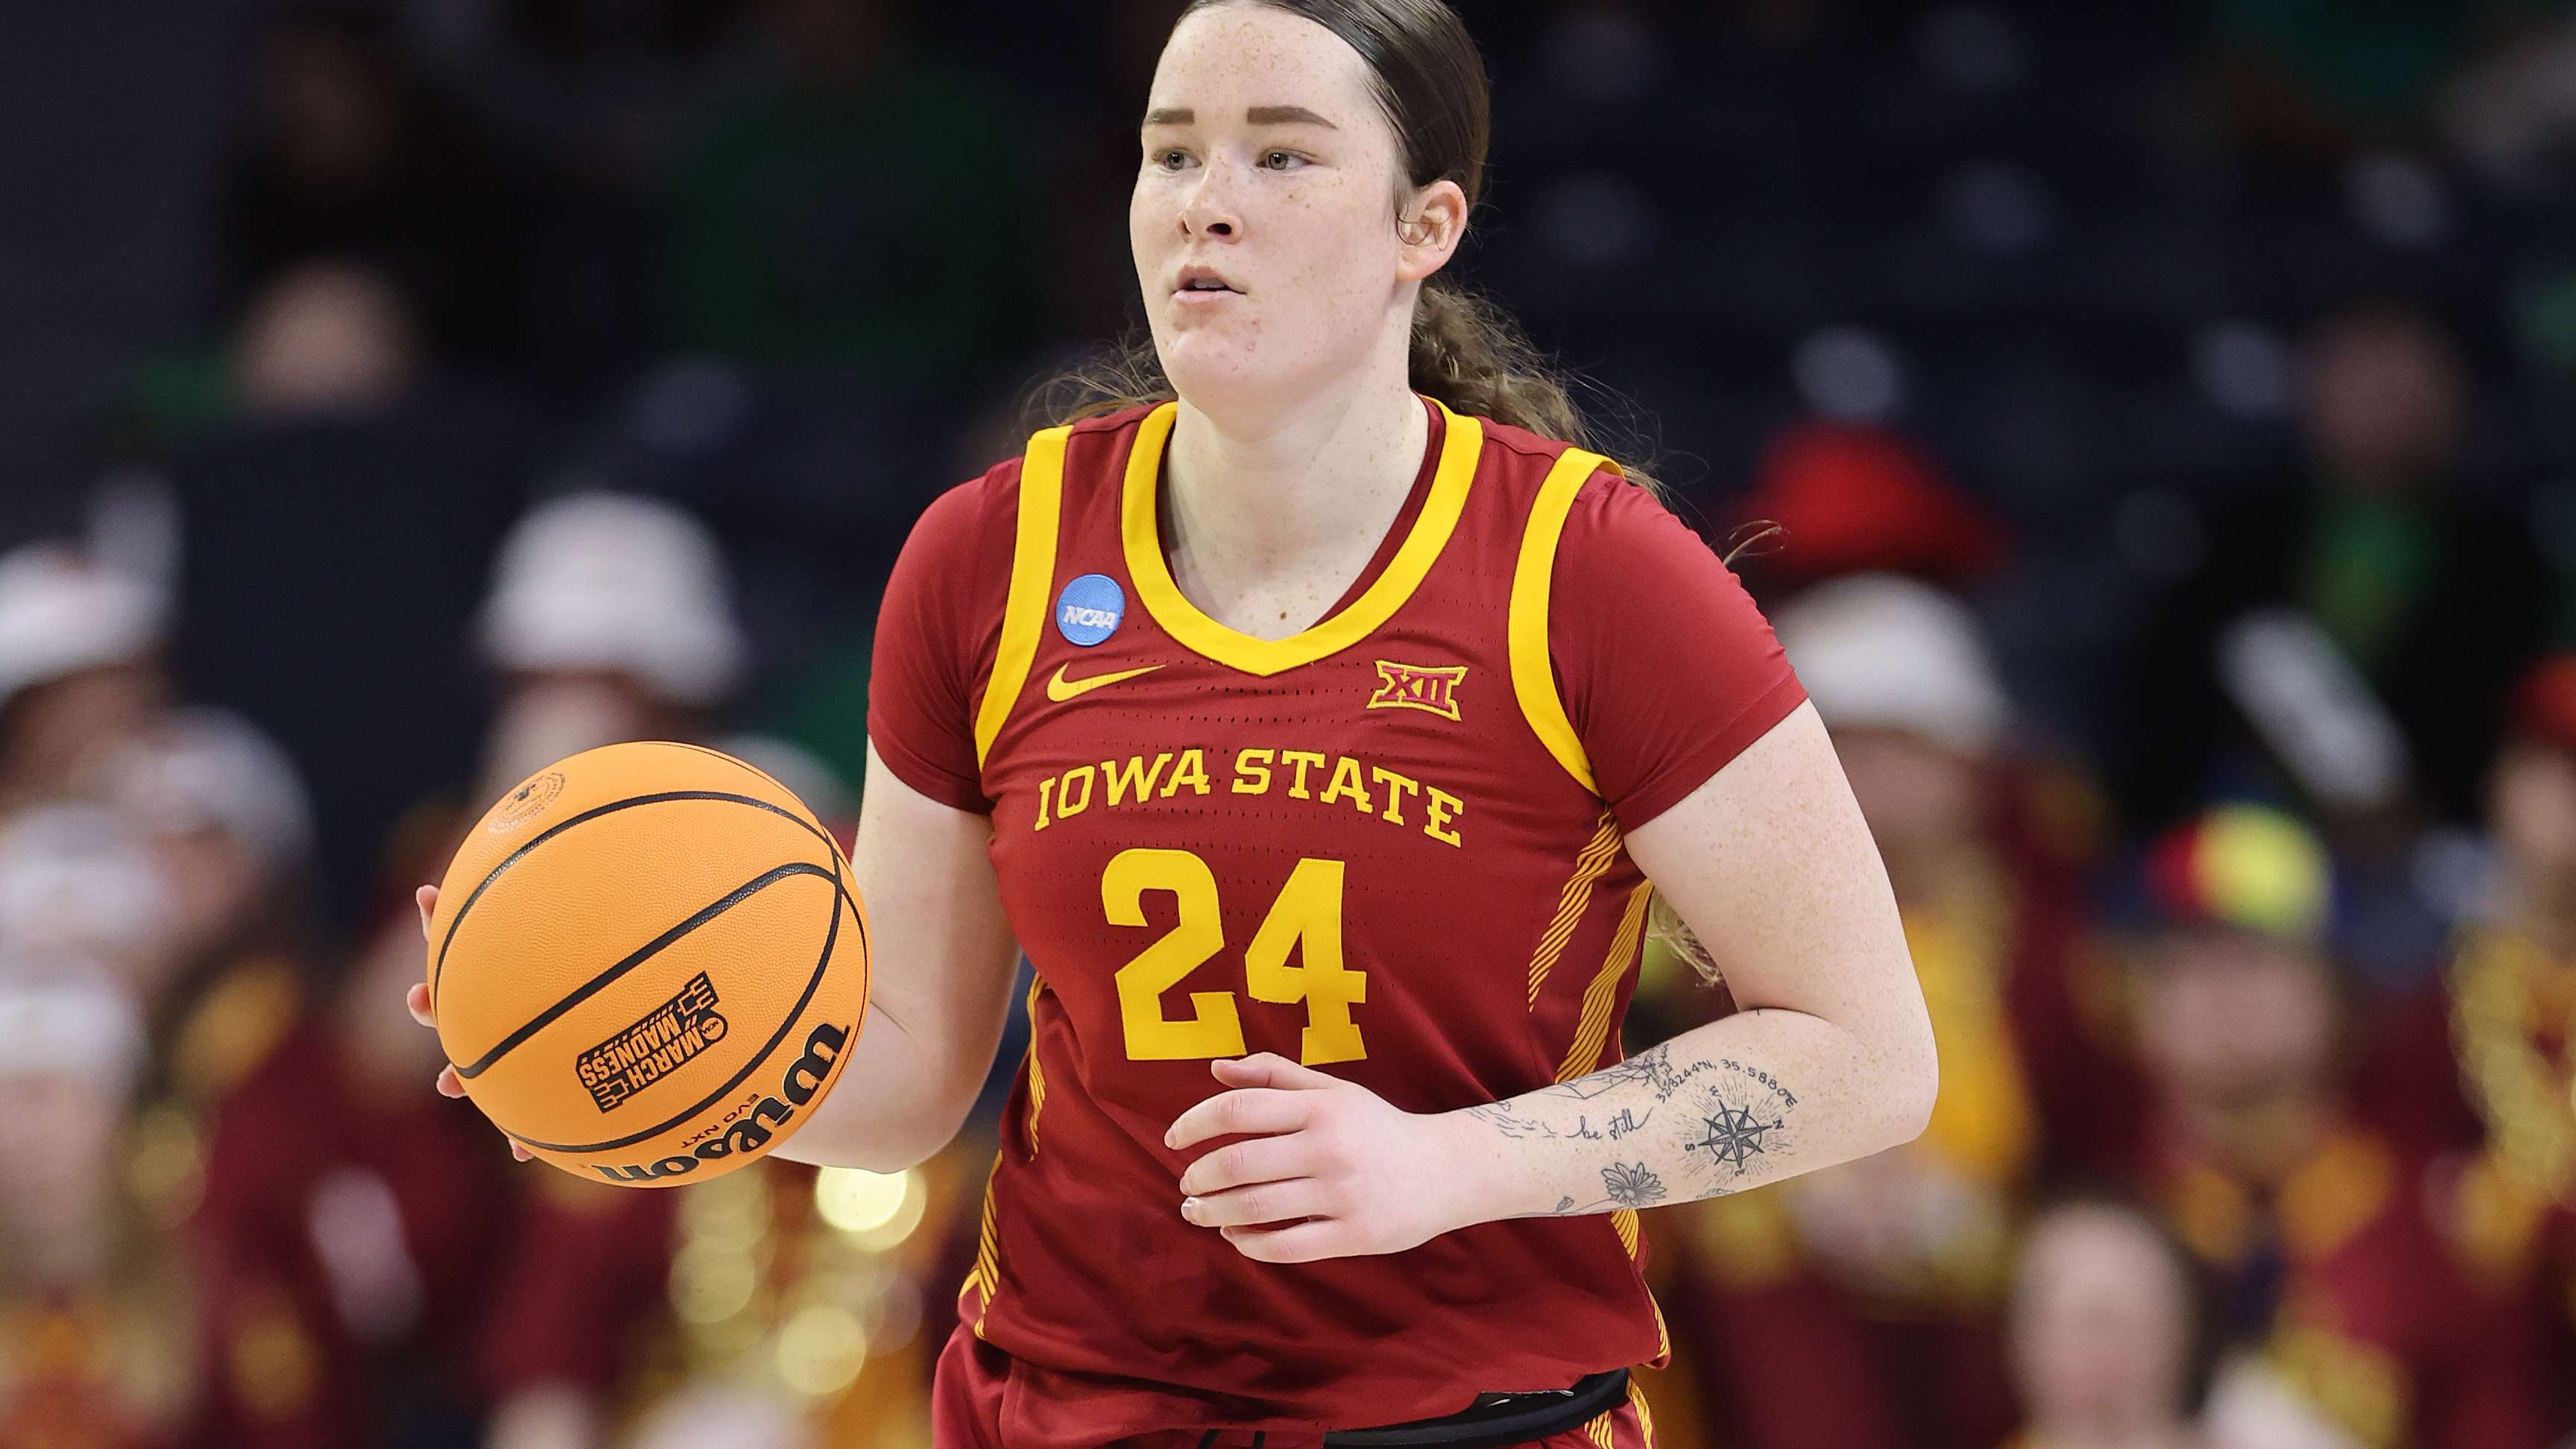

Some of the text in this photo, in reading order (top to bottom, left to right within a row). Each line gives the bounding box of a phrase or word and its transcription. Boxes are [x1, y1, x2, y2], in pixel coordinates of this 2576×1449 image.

[1062, 604, 1118, 631] NCAA
[1379, 665, 1453, 712] XII
[1034, 748, 1464, 848] IOWA STATE
[1101, 848, 1368, 1067] 24
[579, 1004, 682, 1087] MADNESS
[625, 1014, 705, 1090] MARCH
[593, 1023, 850, 1181] Wilson
[681, 1093, 760, 1149] EVO NXT
[1566, 1106, 1654, 1141] be still
